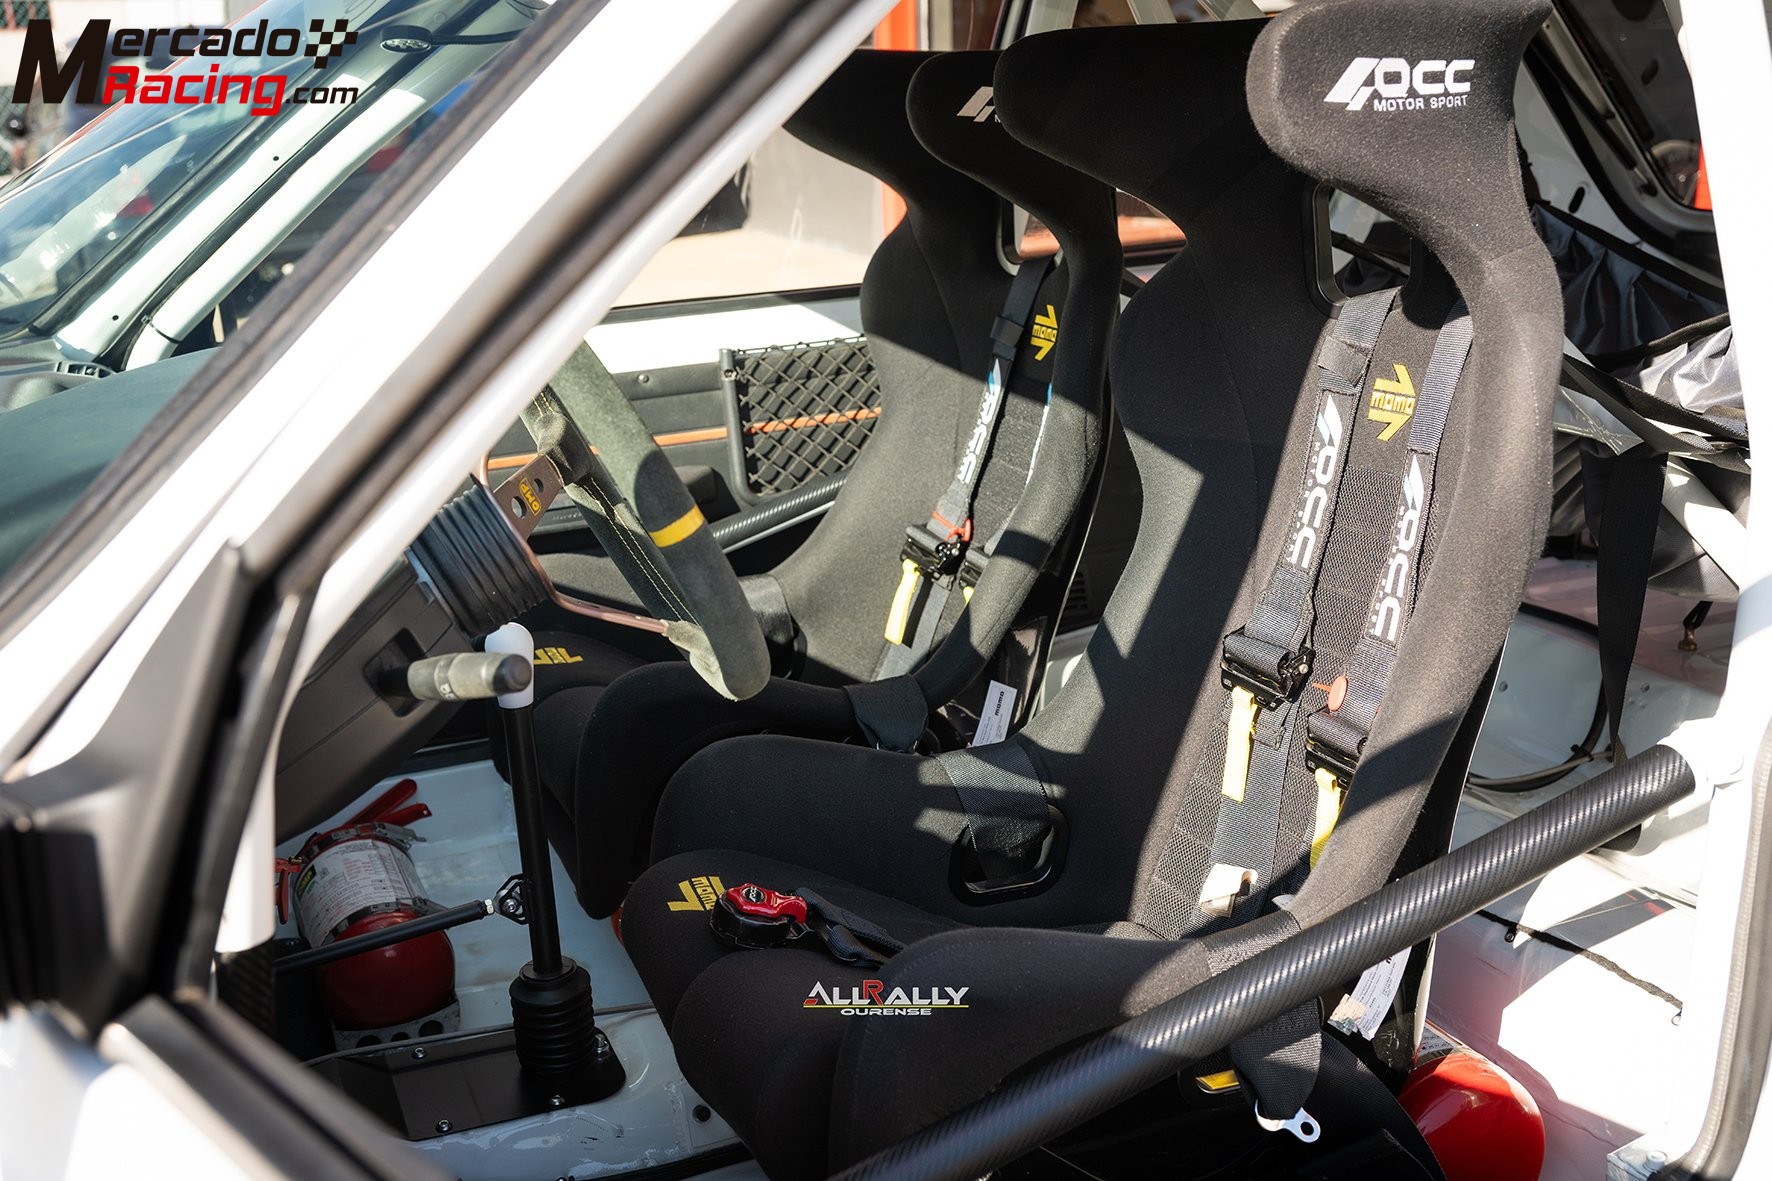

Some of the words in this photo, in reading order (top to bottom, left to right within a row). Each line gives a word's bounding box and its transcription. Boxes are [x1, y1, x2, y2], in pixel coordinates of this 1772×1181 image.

[1373, 98, 1425, 112] MOTOR
[1430, 95, 1468, 109] SPORT
[519, 483, 541, 512] OMP
[994, 690, 1005, 717] momo
